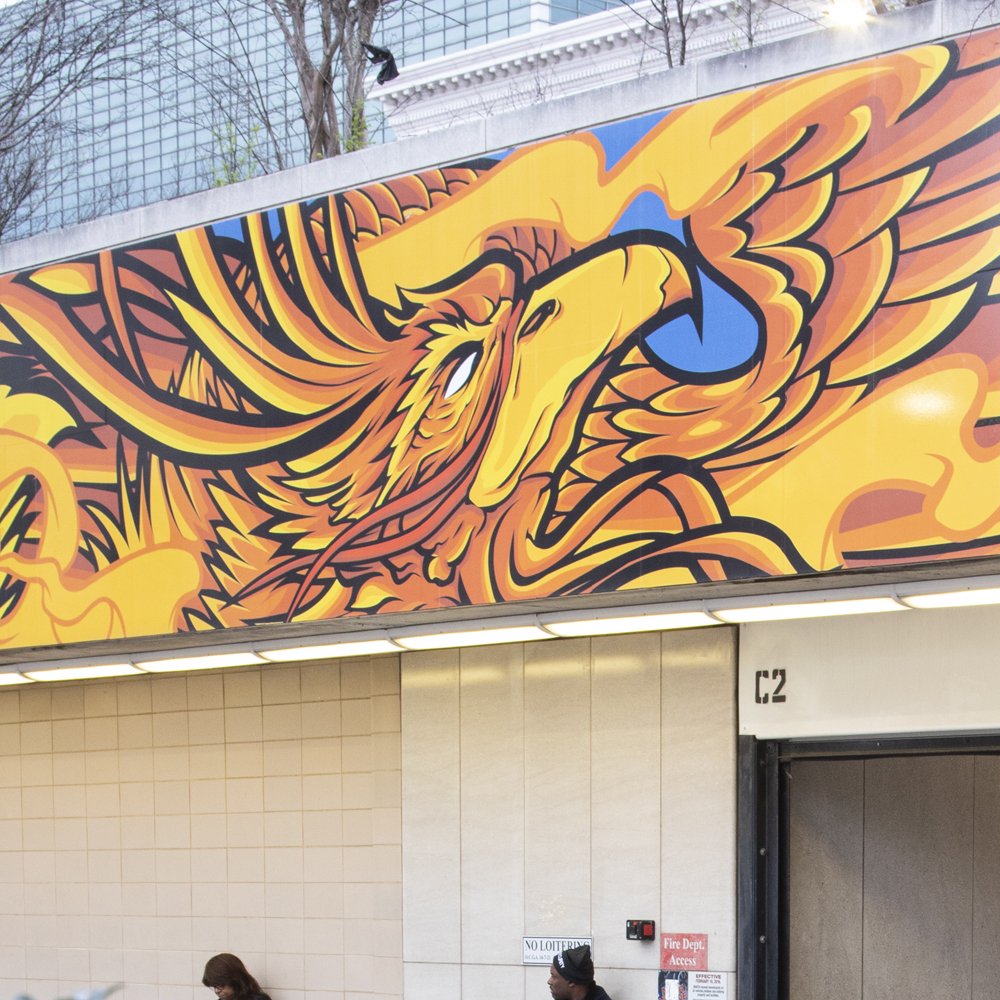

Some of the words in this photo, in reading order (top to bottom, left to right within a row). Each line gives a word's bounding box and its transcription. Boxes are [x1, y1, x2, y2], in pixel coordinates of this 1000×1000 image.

[755, 669, 786, 704] C2
[525, 940, 538, 951] NO
[663, 937, 681, 950] Fire
[682, 938, 705, 953] Dept.
[669, 954, 697, 966] Access
